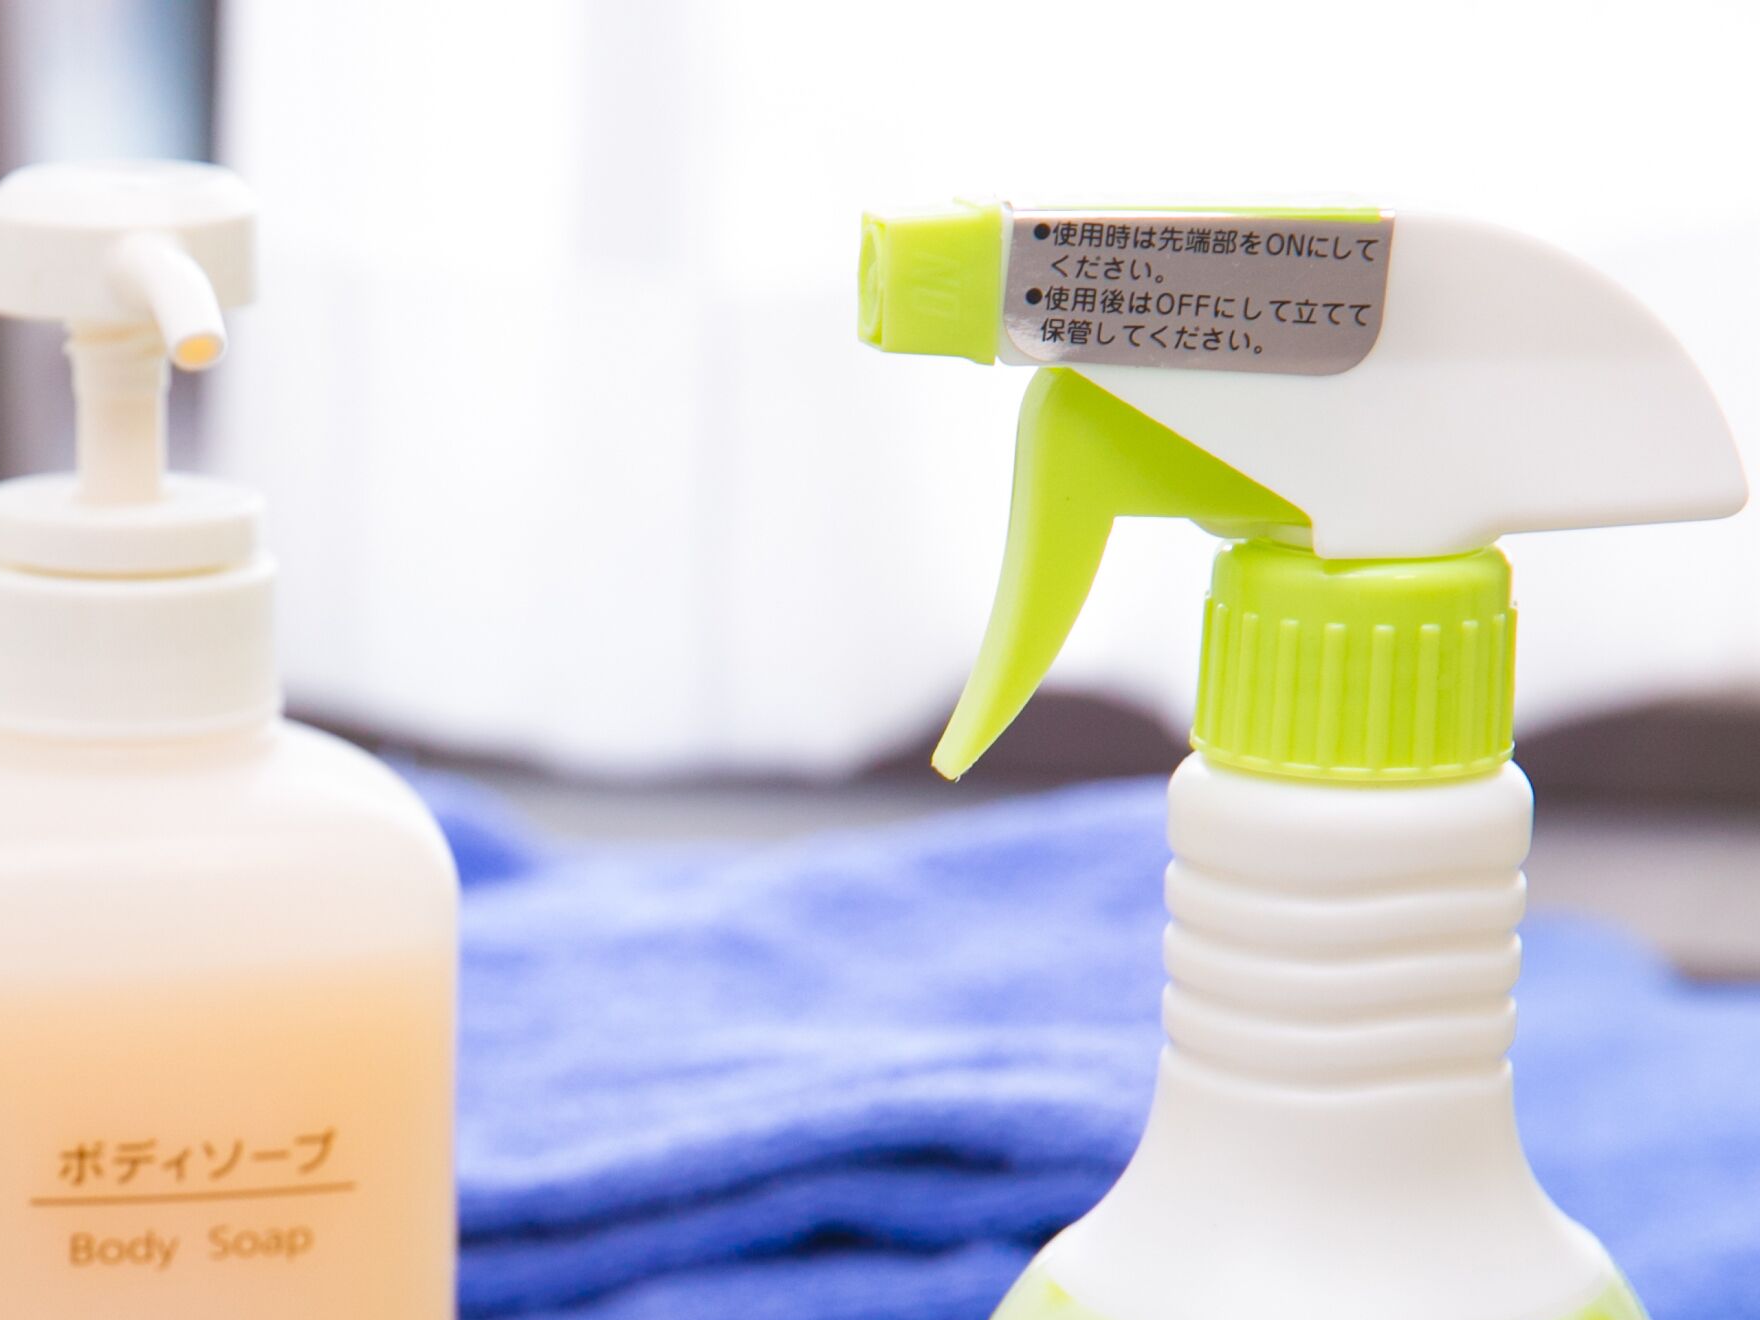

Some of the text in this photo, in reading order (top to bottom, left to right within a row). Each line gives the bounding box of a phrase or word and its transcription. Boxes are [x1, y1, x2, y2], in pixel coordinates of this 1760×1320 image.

[1051, 254, 1166, 284] ください。
[1041, 318, 1264, 355] 保管してください。
[57, 1127, 338, 1187] ボディソープ
[68, 1222, 314, 1271] Body Soap
